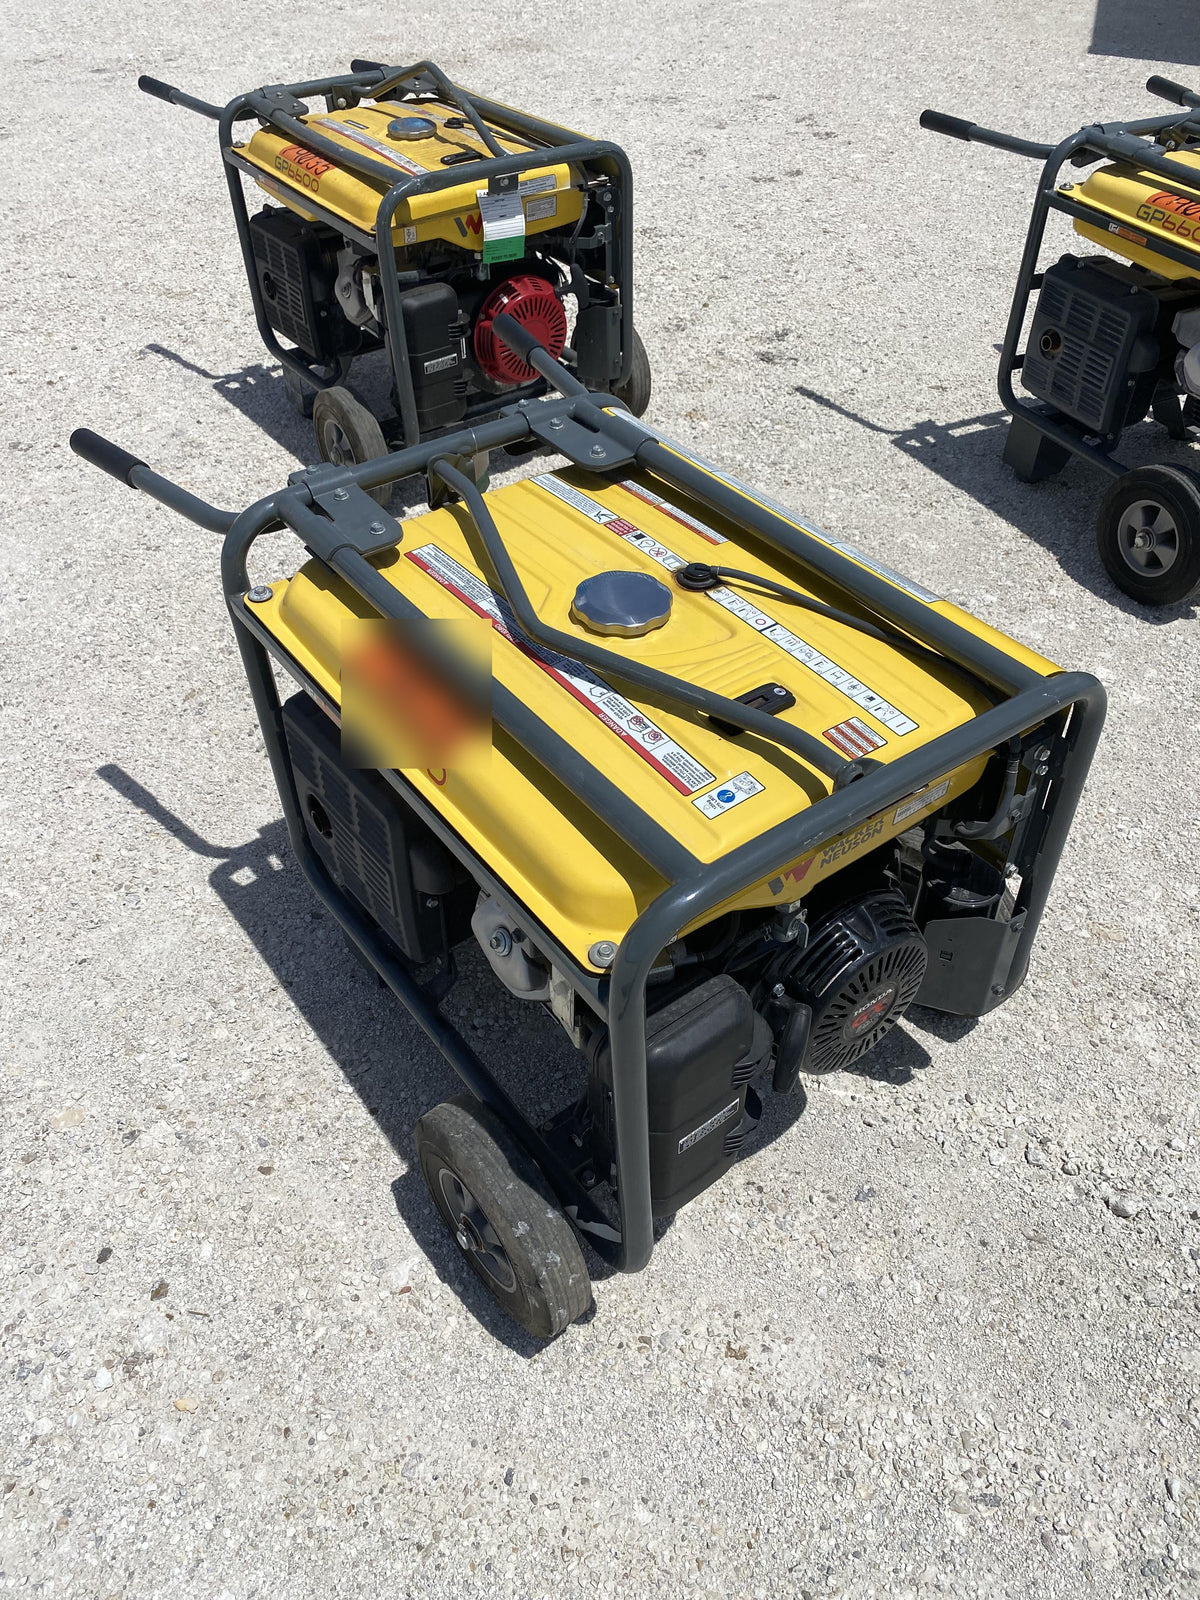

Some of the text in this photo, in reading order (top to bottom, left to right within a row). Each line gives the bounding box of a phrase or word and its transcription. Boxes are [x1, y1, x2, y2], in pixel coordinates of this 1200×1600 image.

[274, 155, 320, 193] GP6600
[598, 712, 623, 734] DANGER
[820, 824, 884, 869] NEUSON
[821, 816, 885, 857] WACKER
[854, 988, 894, 1017] HONDA
